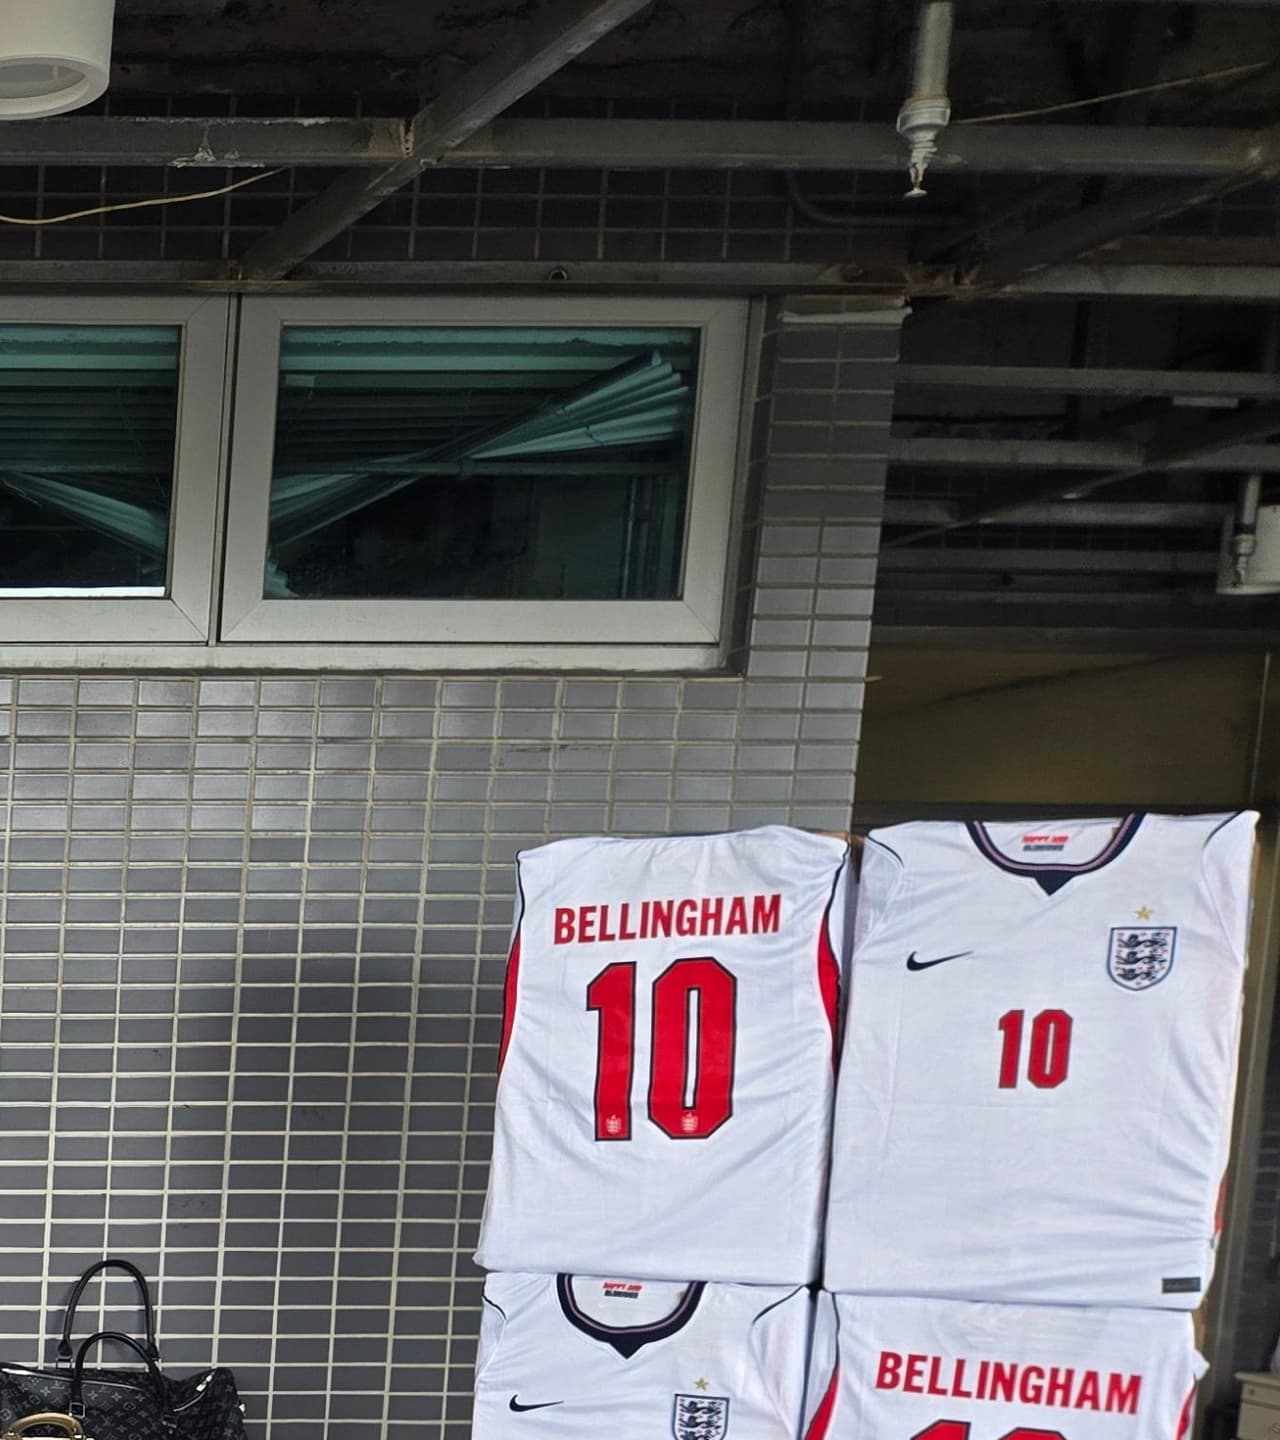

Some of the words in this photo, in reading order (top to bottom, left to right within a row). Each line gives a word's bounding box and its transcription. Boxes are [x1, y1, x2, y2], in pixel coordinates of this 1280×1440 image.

[552, 893, 782, 945] BELLINGHAM
[585, 955, 738, 1141] 10
[997, 1008, 1074, 1090] 10
[875, 1350, 1143, 1416] BELLINGHAM
